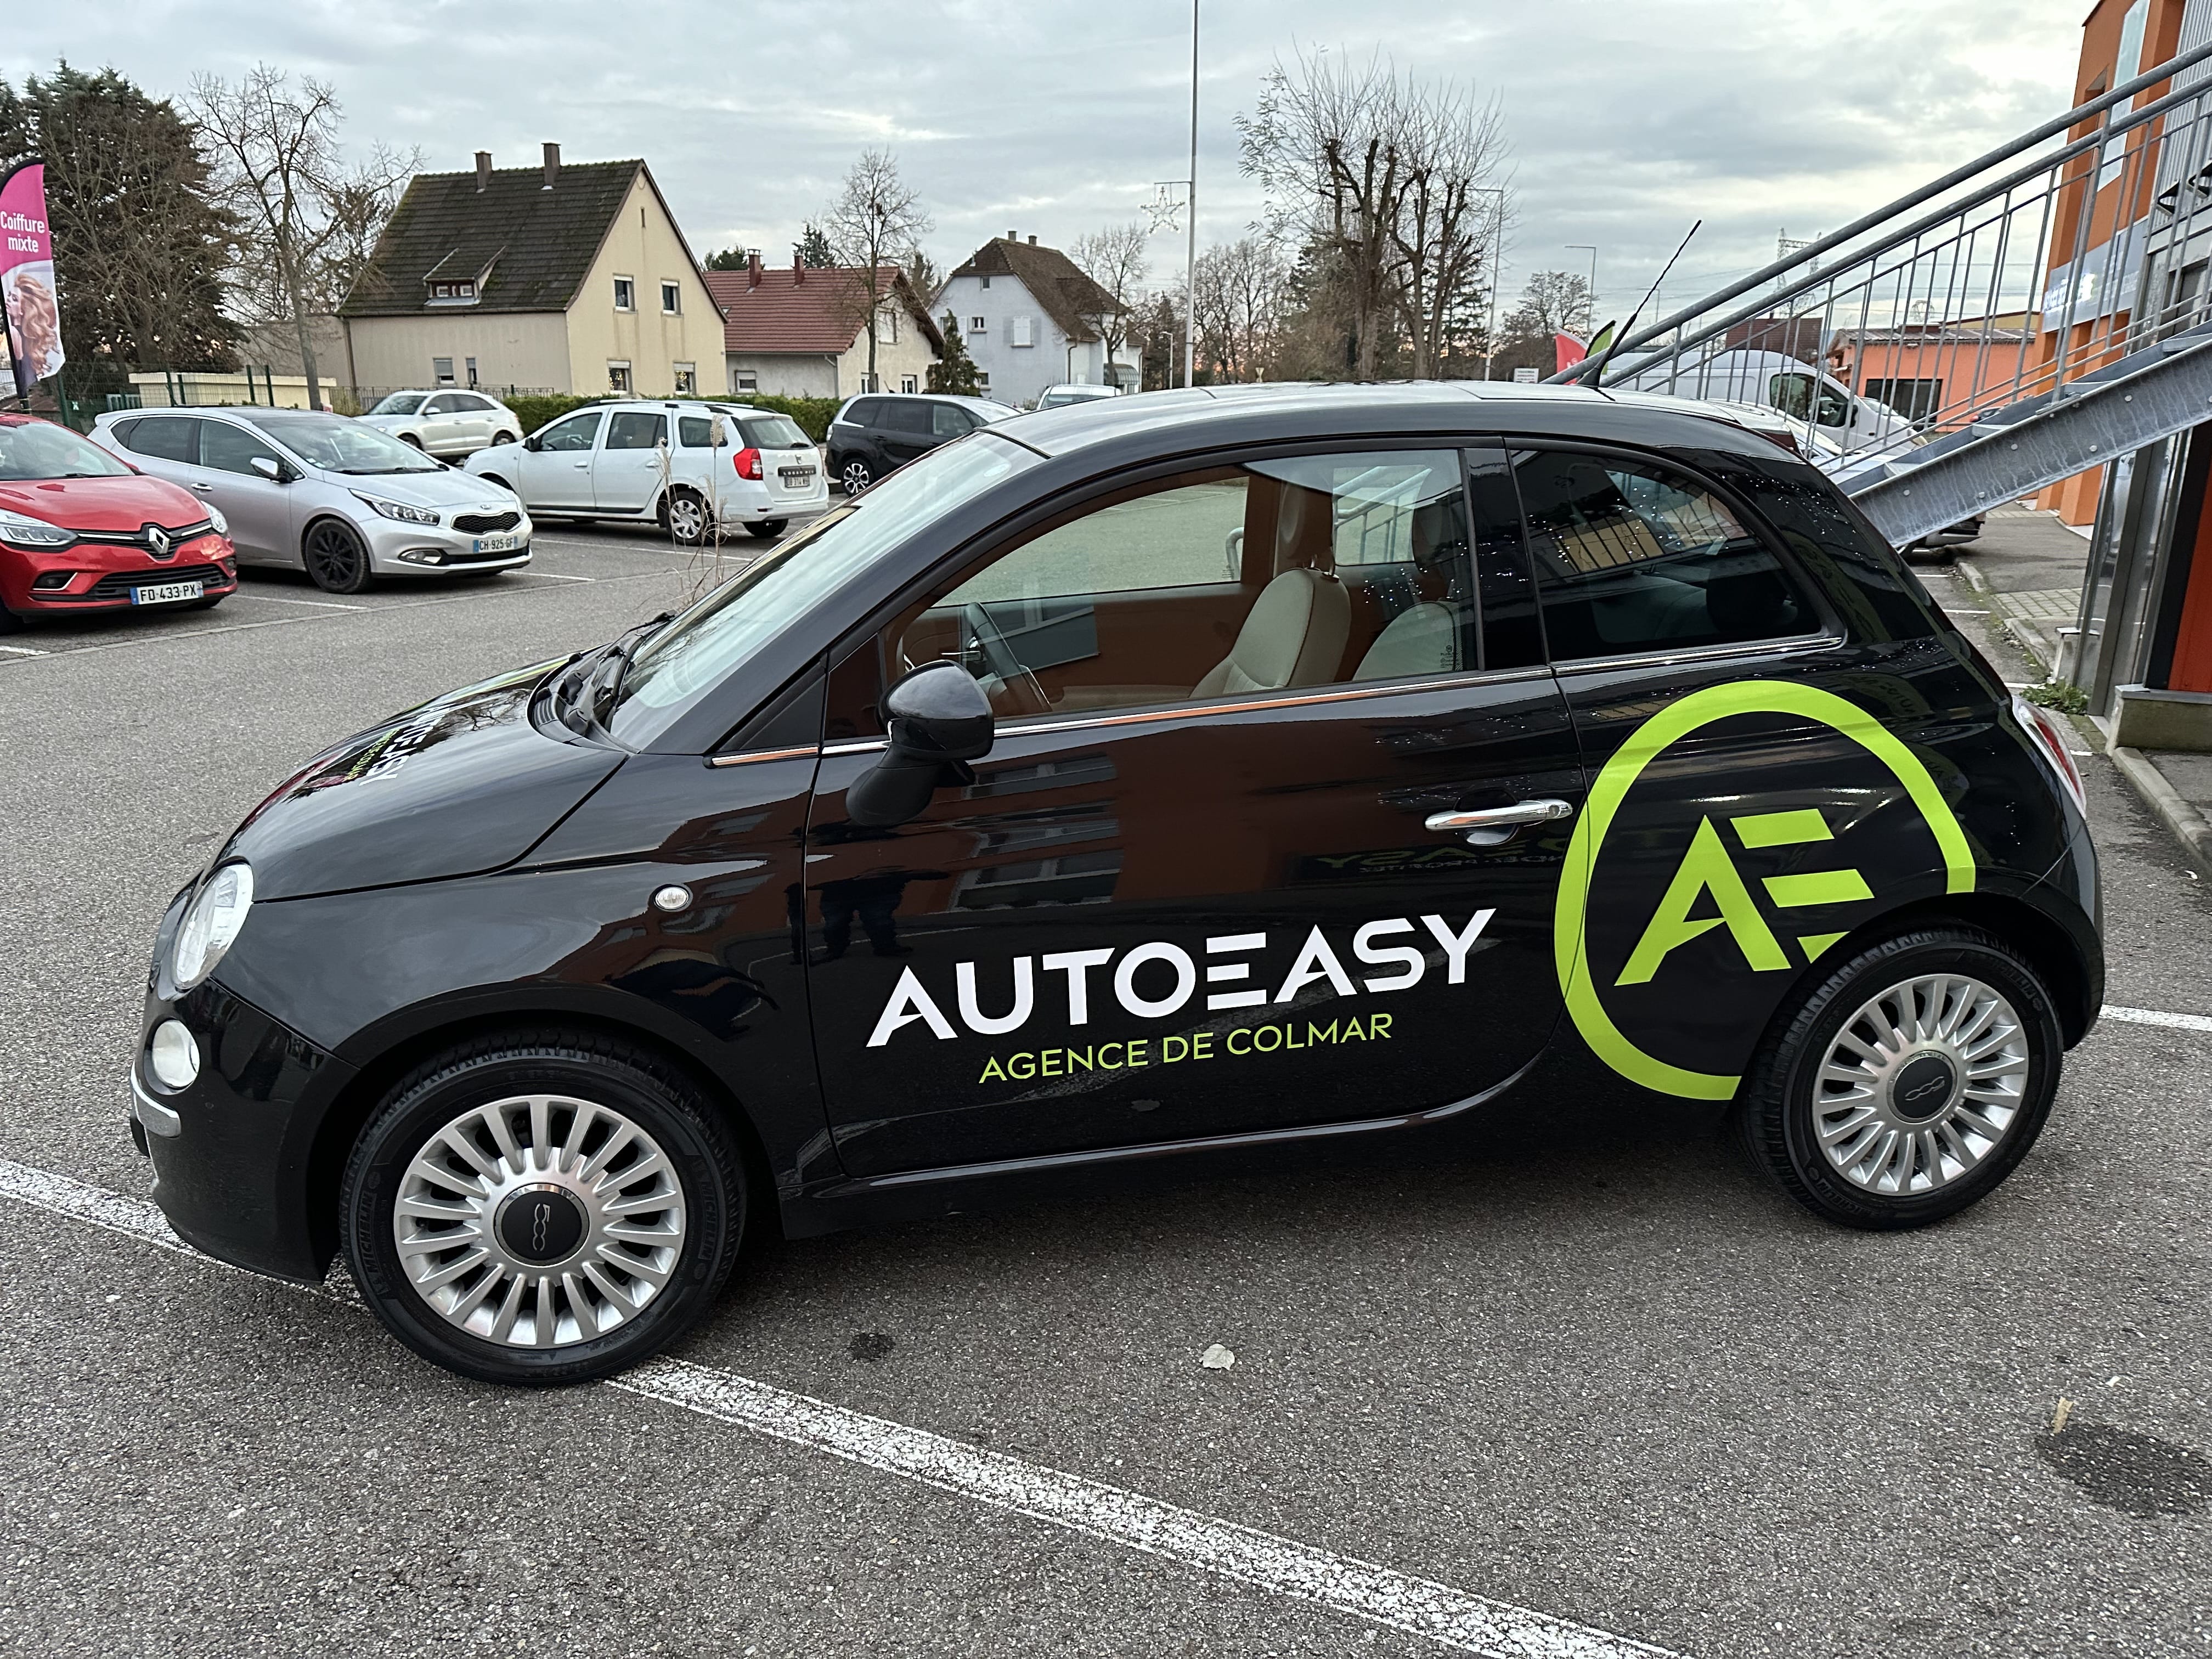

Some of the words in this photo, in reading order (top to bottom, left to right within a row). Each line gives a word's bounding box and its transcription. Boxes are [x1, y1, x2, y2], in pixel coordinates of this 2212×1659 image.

[0, 211, 45, 234] Coiffure
[8, 233, 39, 253] mixte
[1614, 809, 1875, 986] AE
[865, 908, 1497, 1048] AUTOEASY
[979, 1039, 1148, 1084] AGENCE
[1163, 1032, 1214, 1063] DE
[1227, 1013, 1393, 1056] COLMAR
